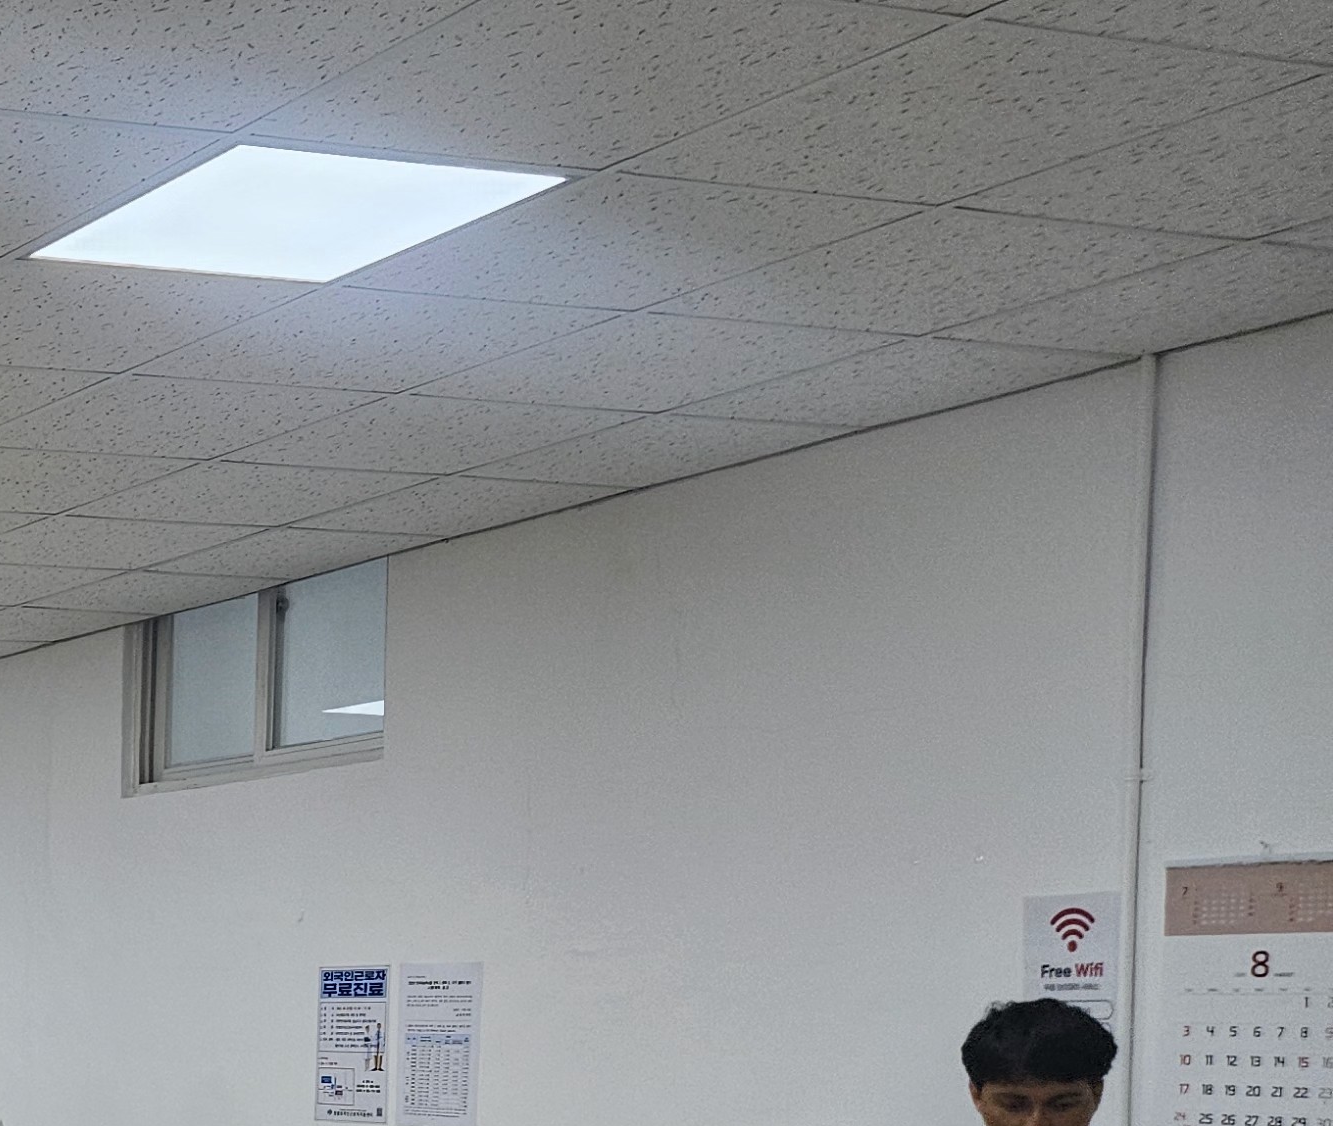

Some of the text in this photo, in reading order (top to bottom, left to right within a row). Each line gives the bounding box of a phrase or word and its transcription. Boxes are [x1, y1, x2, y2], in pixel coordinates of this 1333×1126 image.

[1041, 961, 1104, 978] Free Wifi
[1251, 950, 1270, 978] 8
[323, 969, 386, 982] 외국인근로자
[323, 982, 384, 998] 무료진료
[1304, 996, 1309, 1008] 1
[1183, 1025, 1190, 1037] 3
[1206, 1025, 1215, 1036] 4
[1229, 1025, 1238, 1037] 5
[1253, 1026, 1261, 1037] 6
[1277, 1026, 1285, 1037] 7
[1300, 1027, 1308, 1038] 8
[1180, 1054, 1191, 1066] 10
[1205, 1055, 1213, 1066] 11
[1226, 1055, 1238, 1066] 12
[1250, 1056, 1261, 1067] 13
[1274, 1056, 1285, 1067] 14
[1298, 1056, 1309, 1068] 15
[1179, 1083, 1189, 1094] 17
[1202, 1084, 1213, 1095] 18
[1225, 1084, 1236, 1096] 19
[1245, 1085, 1261, 1097] 20
[1271, 1086, 1283, 1097] 21
[1293, 1087, 1309, 1098] 22
[1199, 1113, 1213, 1124] 25
[1221, 1113, 1236, 1126] 26
[1244, 1115, 1259, 1126] 27
[1267, 1115, 1283, 1126] 28
